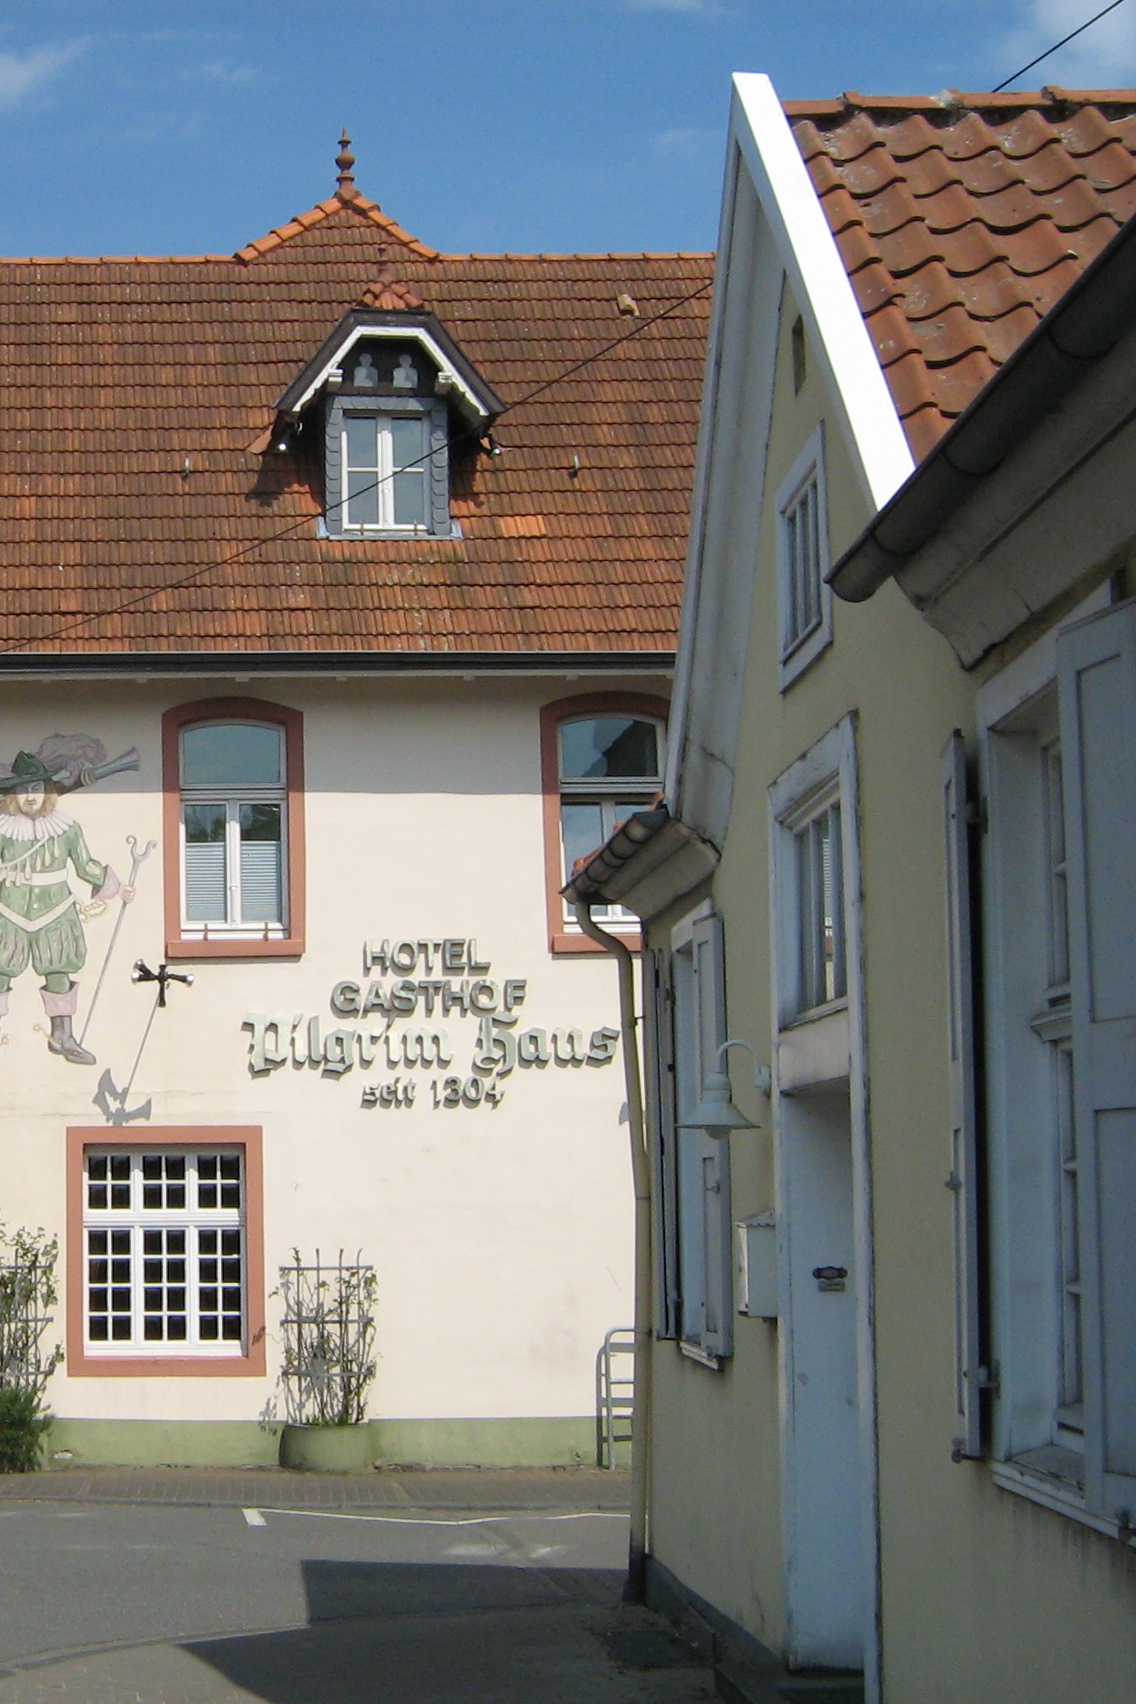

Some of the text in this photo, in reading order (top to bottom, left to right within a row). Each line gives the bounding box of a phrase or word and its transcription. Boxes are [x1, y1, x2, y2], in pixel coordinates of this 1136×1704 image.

[364, 938, 492, 973] HOTEL
[331, 979, 527, 1014] GASTHOF
[241, 1011, 621, 1077] Pilgrim Haus
[361, 1075, 505, 1109] seit 1304
